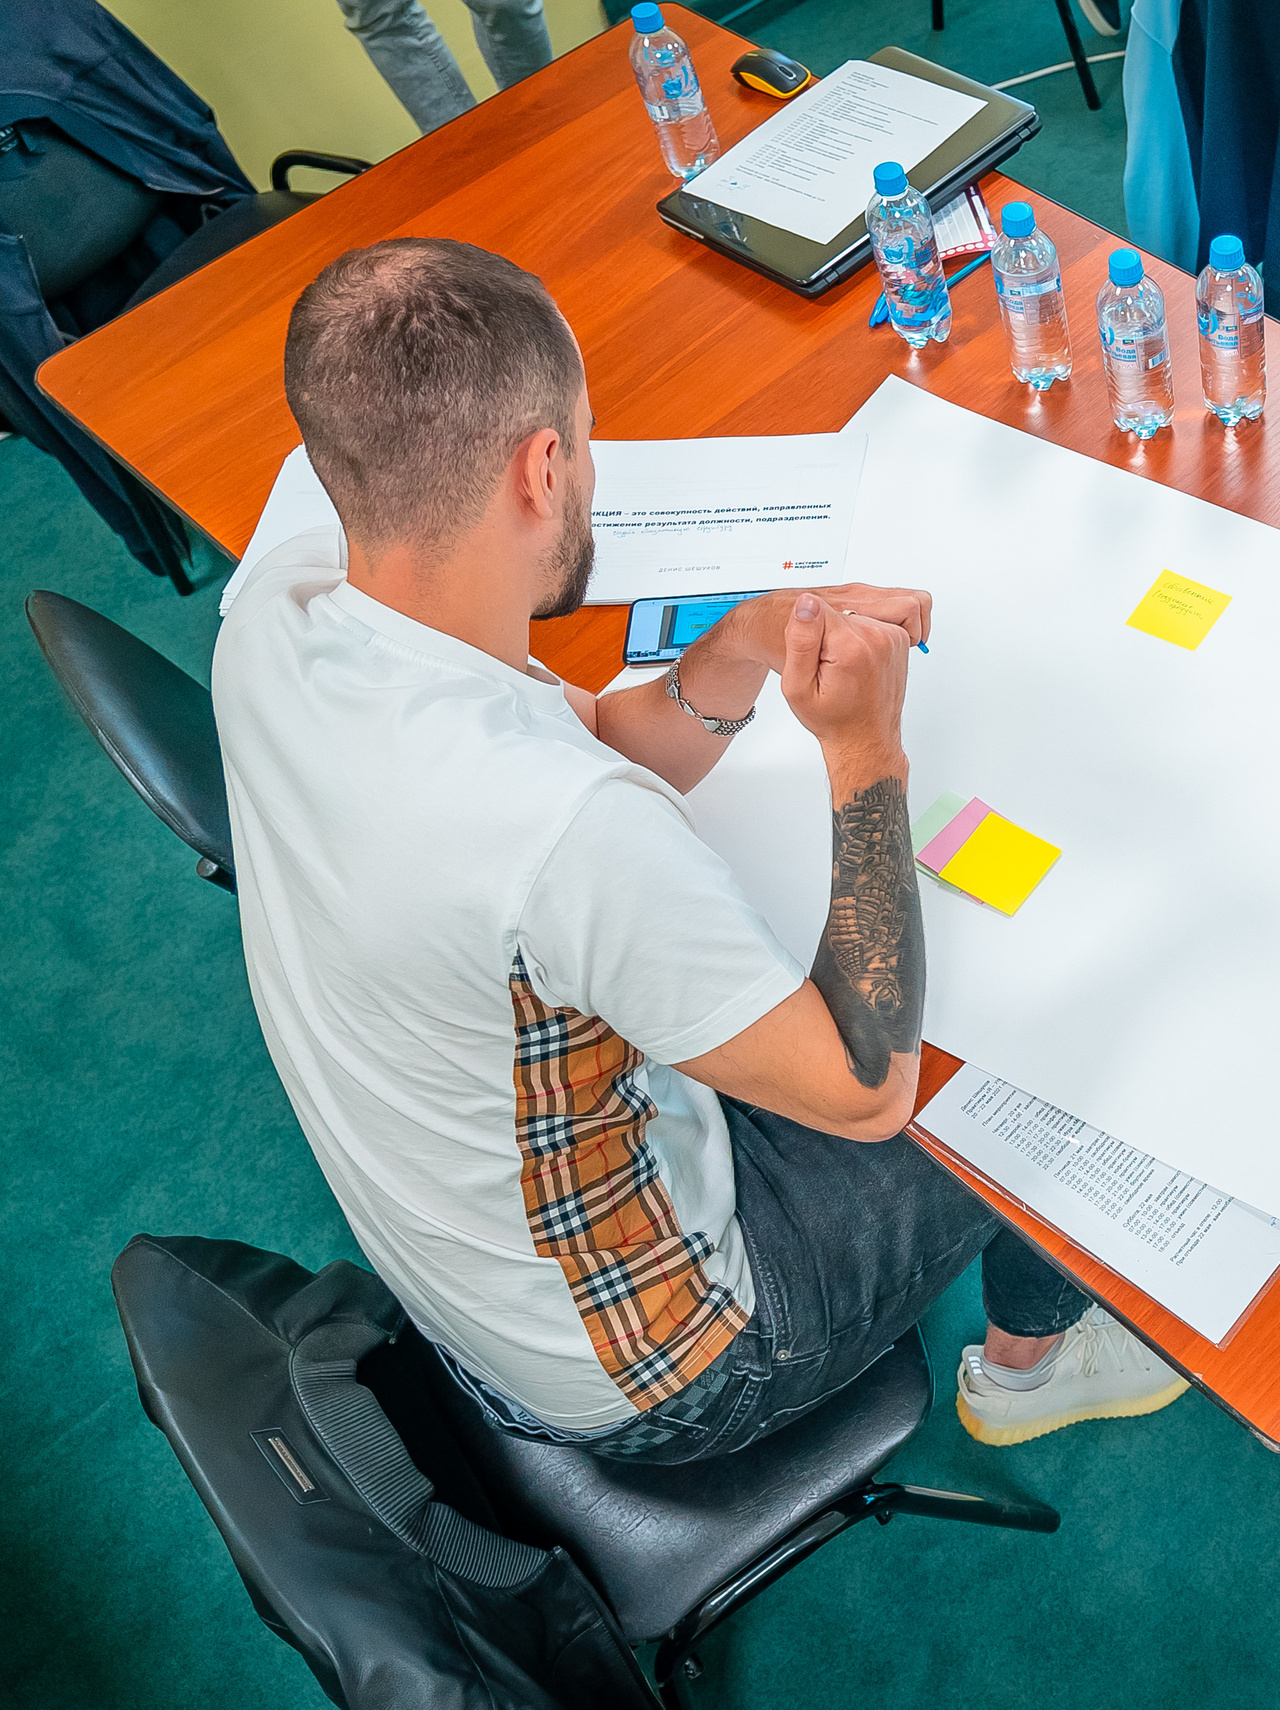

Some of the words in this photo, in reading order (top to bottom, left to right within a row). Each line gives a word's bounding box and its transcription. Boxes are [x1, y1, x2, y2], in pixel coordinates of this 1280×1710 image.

[714, 506, 760, 514] действий,
[763, 503, 832, 511] направленных
[756, 515, 831, 523] подразделения.
[981, 1114, 994, 1127] План
